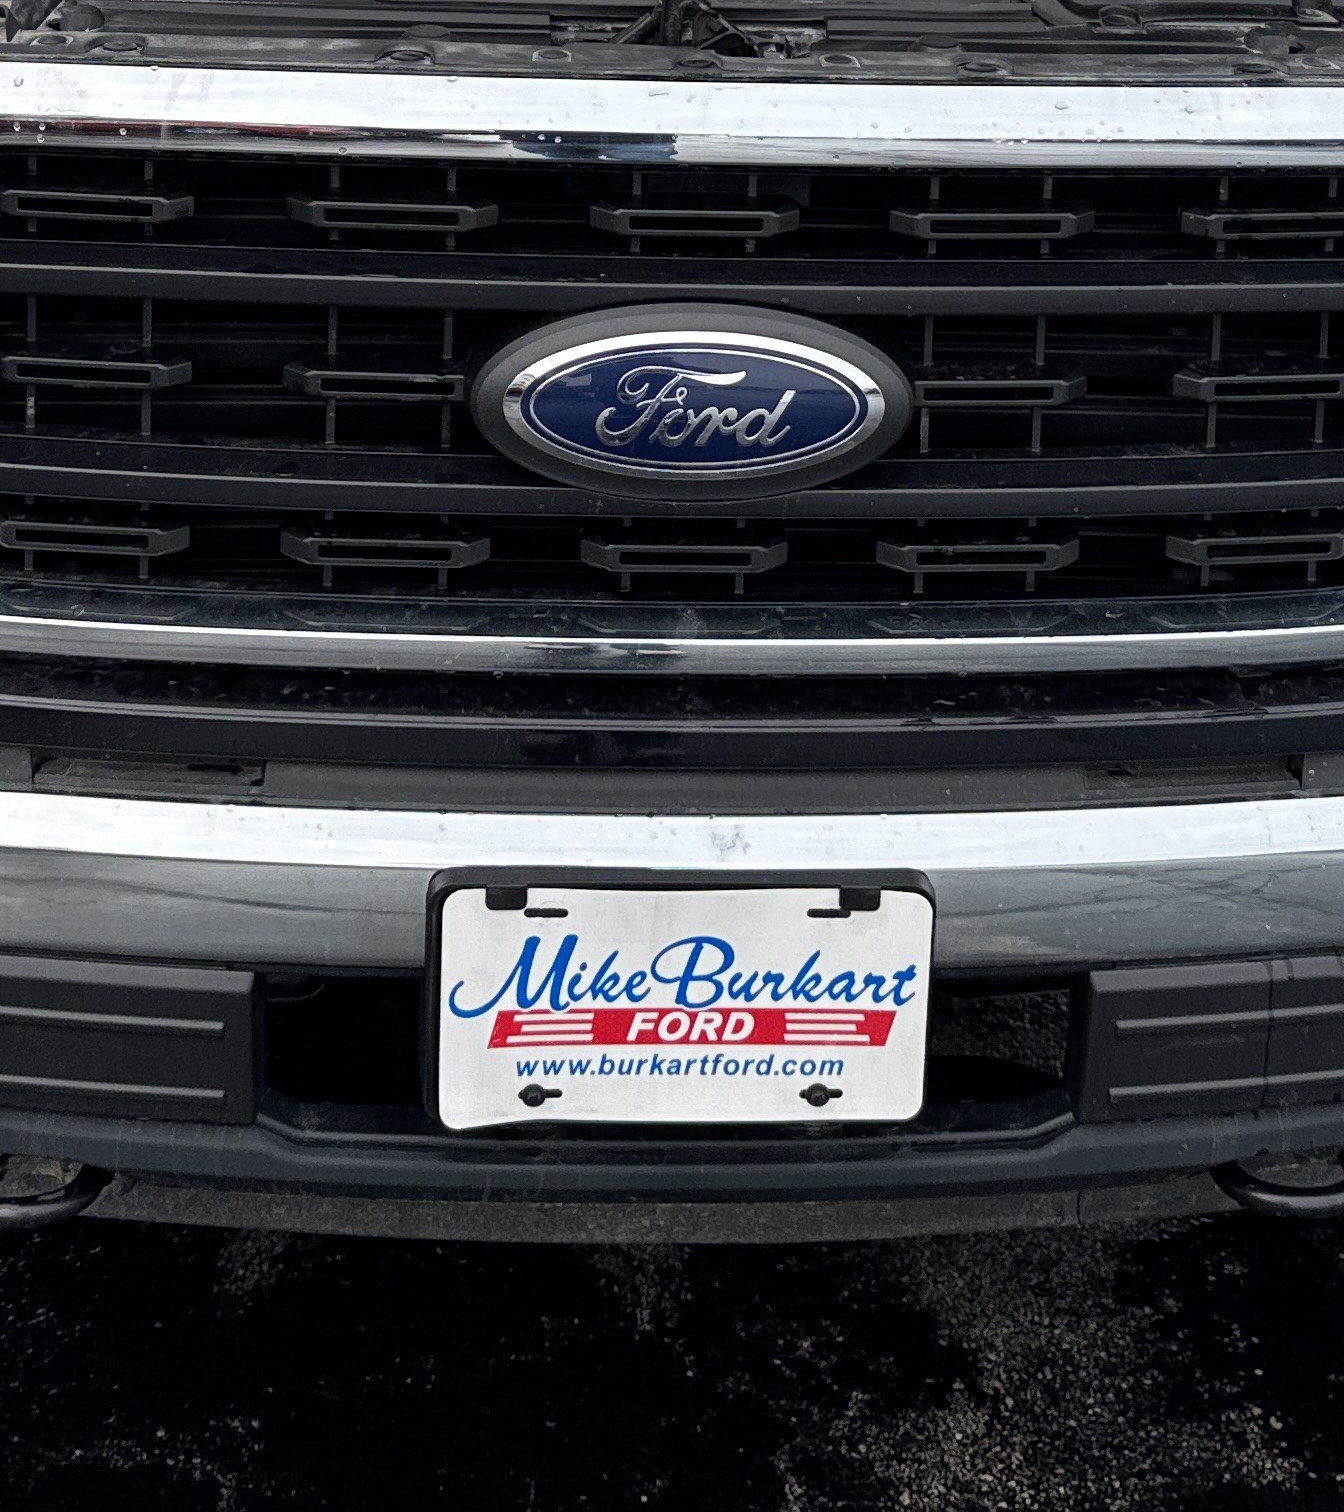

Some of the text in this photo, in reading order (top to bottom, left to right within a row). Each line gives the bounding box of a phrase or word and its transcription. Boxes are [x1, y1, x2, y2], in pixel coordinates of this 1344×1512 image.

[594, 364, 797, 448] Ford
[448, 933, 918, 1020] Mike Burkart
[626, 1011, 756, 1043] FORD
[515, 1054, 845, 1078] www.burkartford.com
